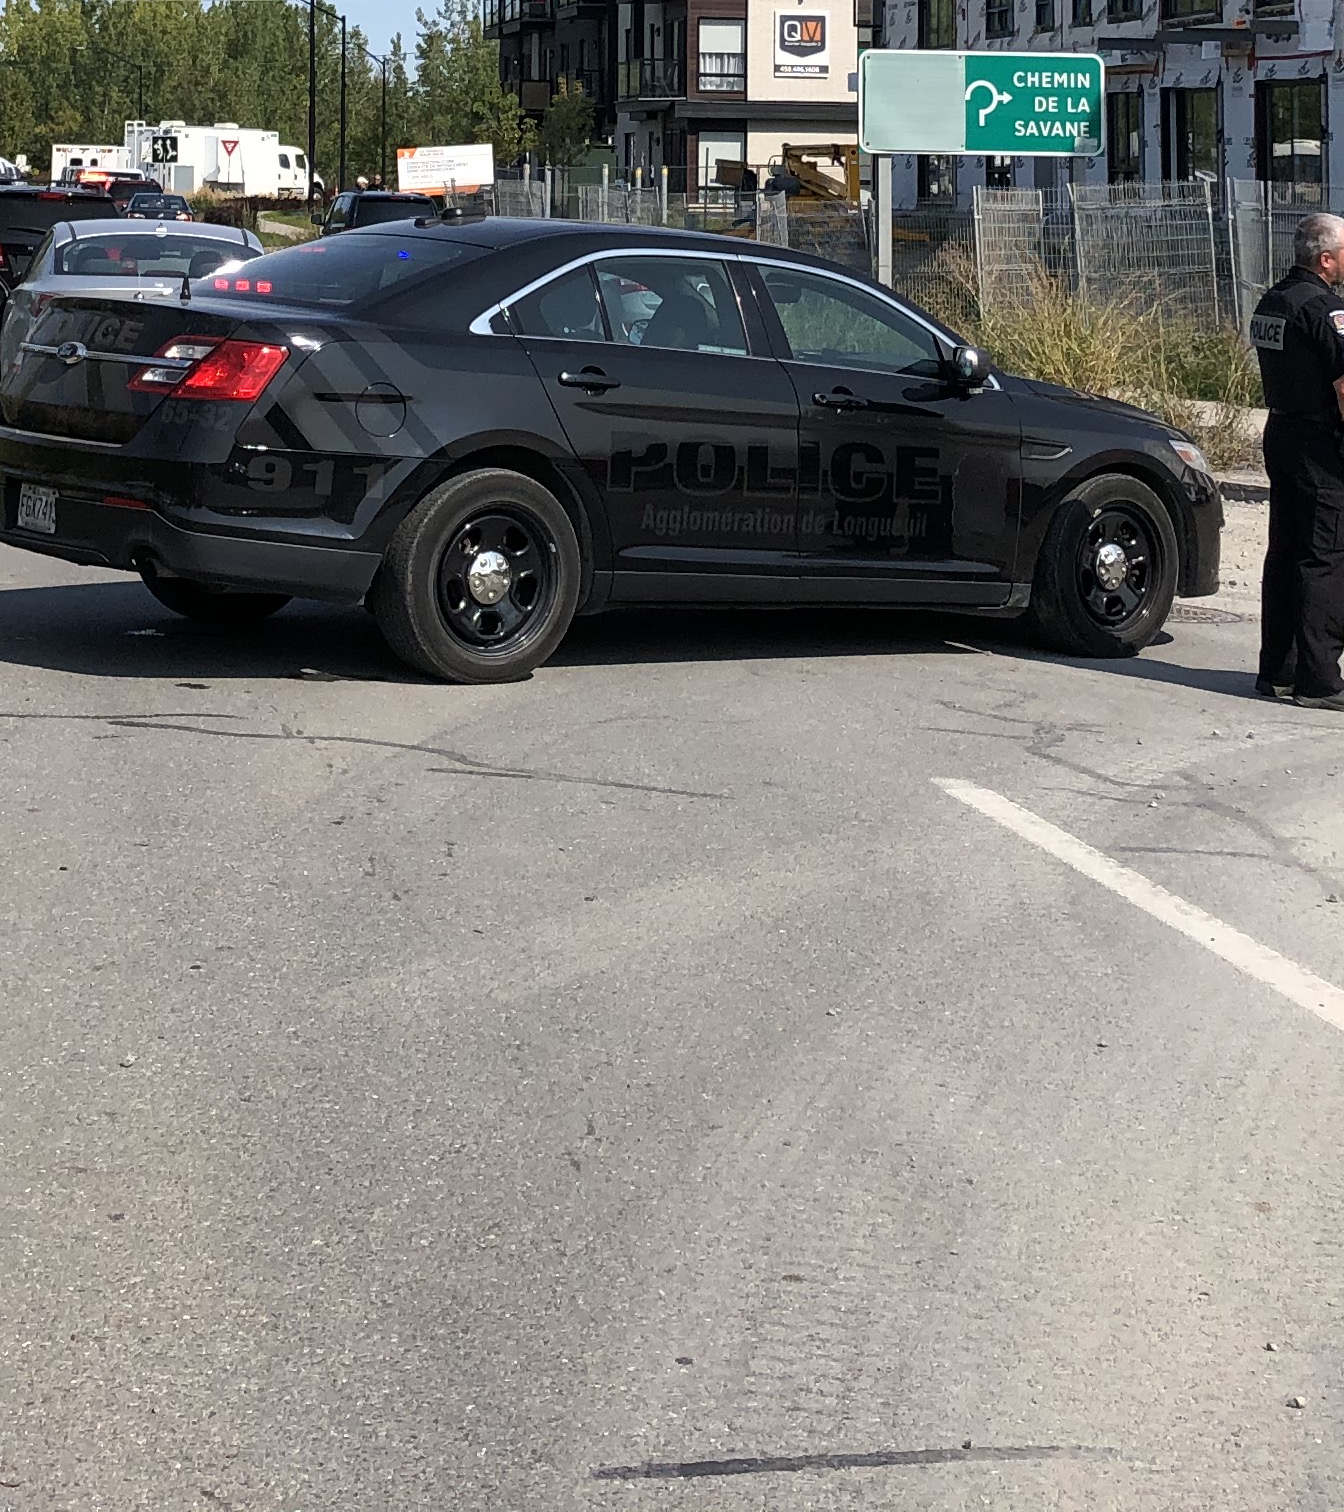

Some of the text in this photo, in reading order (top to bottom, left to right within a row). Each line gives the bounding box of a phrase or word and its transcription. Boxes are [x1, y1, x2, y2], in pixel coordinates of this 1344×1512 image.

[1013, 71, 1090, 89] CHEMIN
[1035, 97, 1091, 113] DE LA
[1014, 120, 1090, 138] SAVANE
[246, 454, 385, 499] 911
[607, 431, 942, 505] POLICE
[641, 502, 795, 538] Agglomération
[801, 506, 827, 535] de
